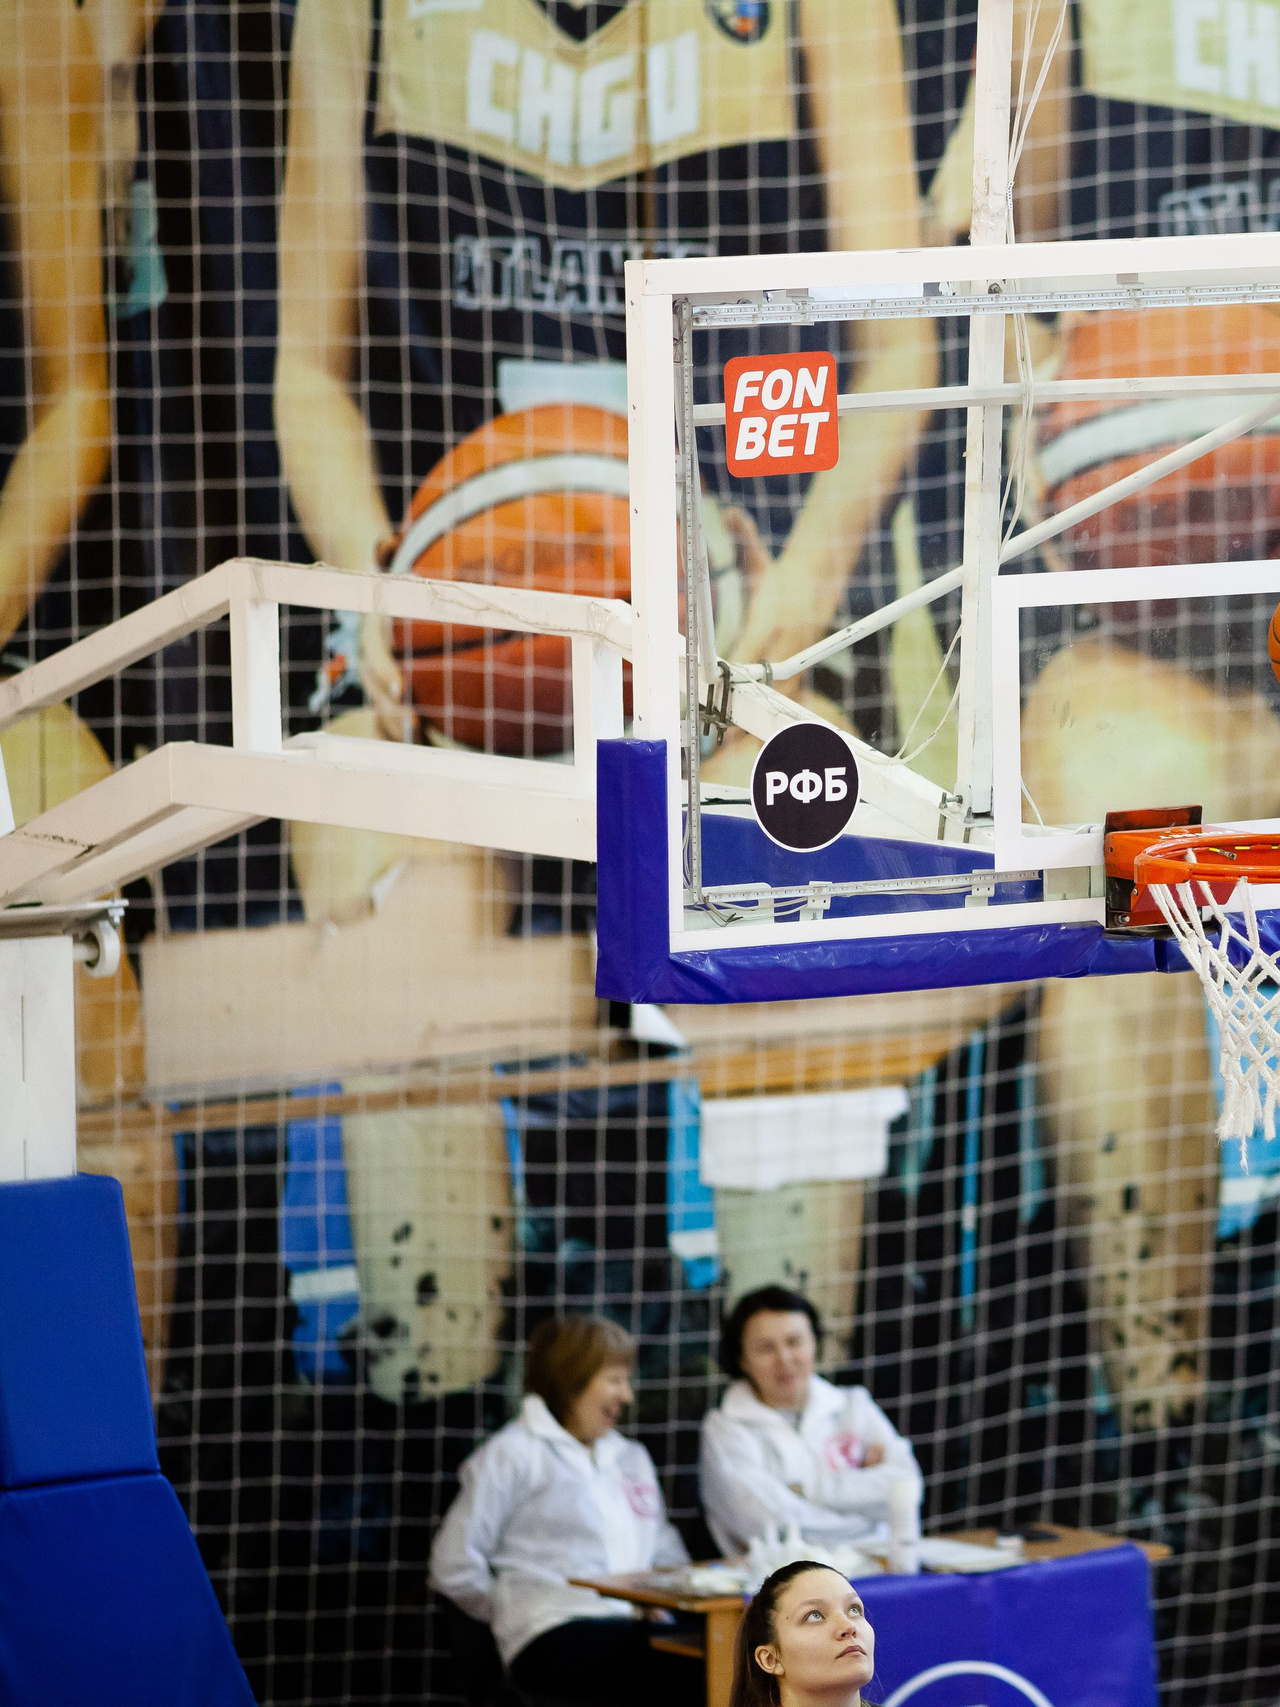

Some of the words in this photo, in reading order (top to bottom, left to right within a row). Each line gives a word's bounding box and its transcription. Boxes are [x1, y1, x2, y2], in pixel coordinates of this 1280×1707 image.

[467, 29, 699, 166] CHGU
[733, 366, 829, 413] FON
[734, 411, 830, 461] BET
[765, 766, 848, 806] РФБ
